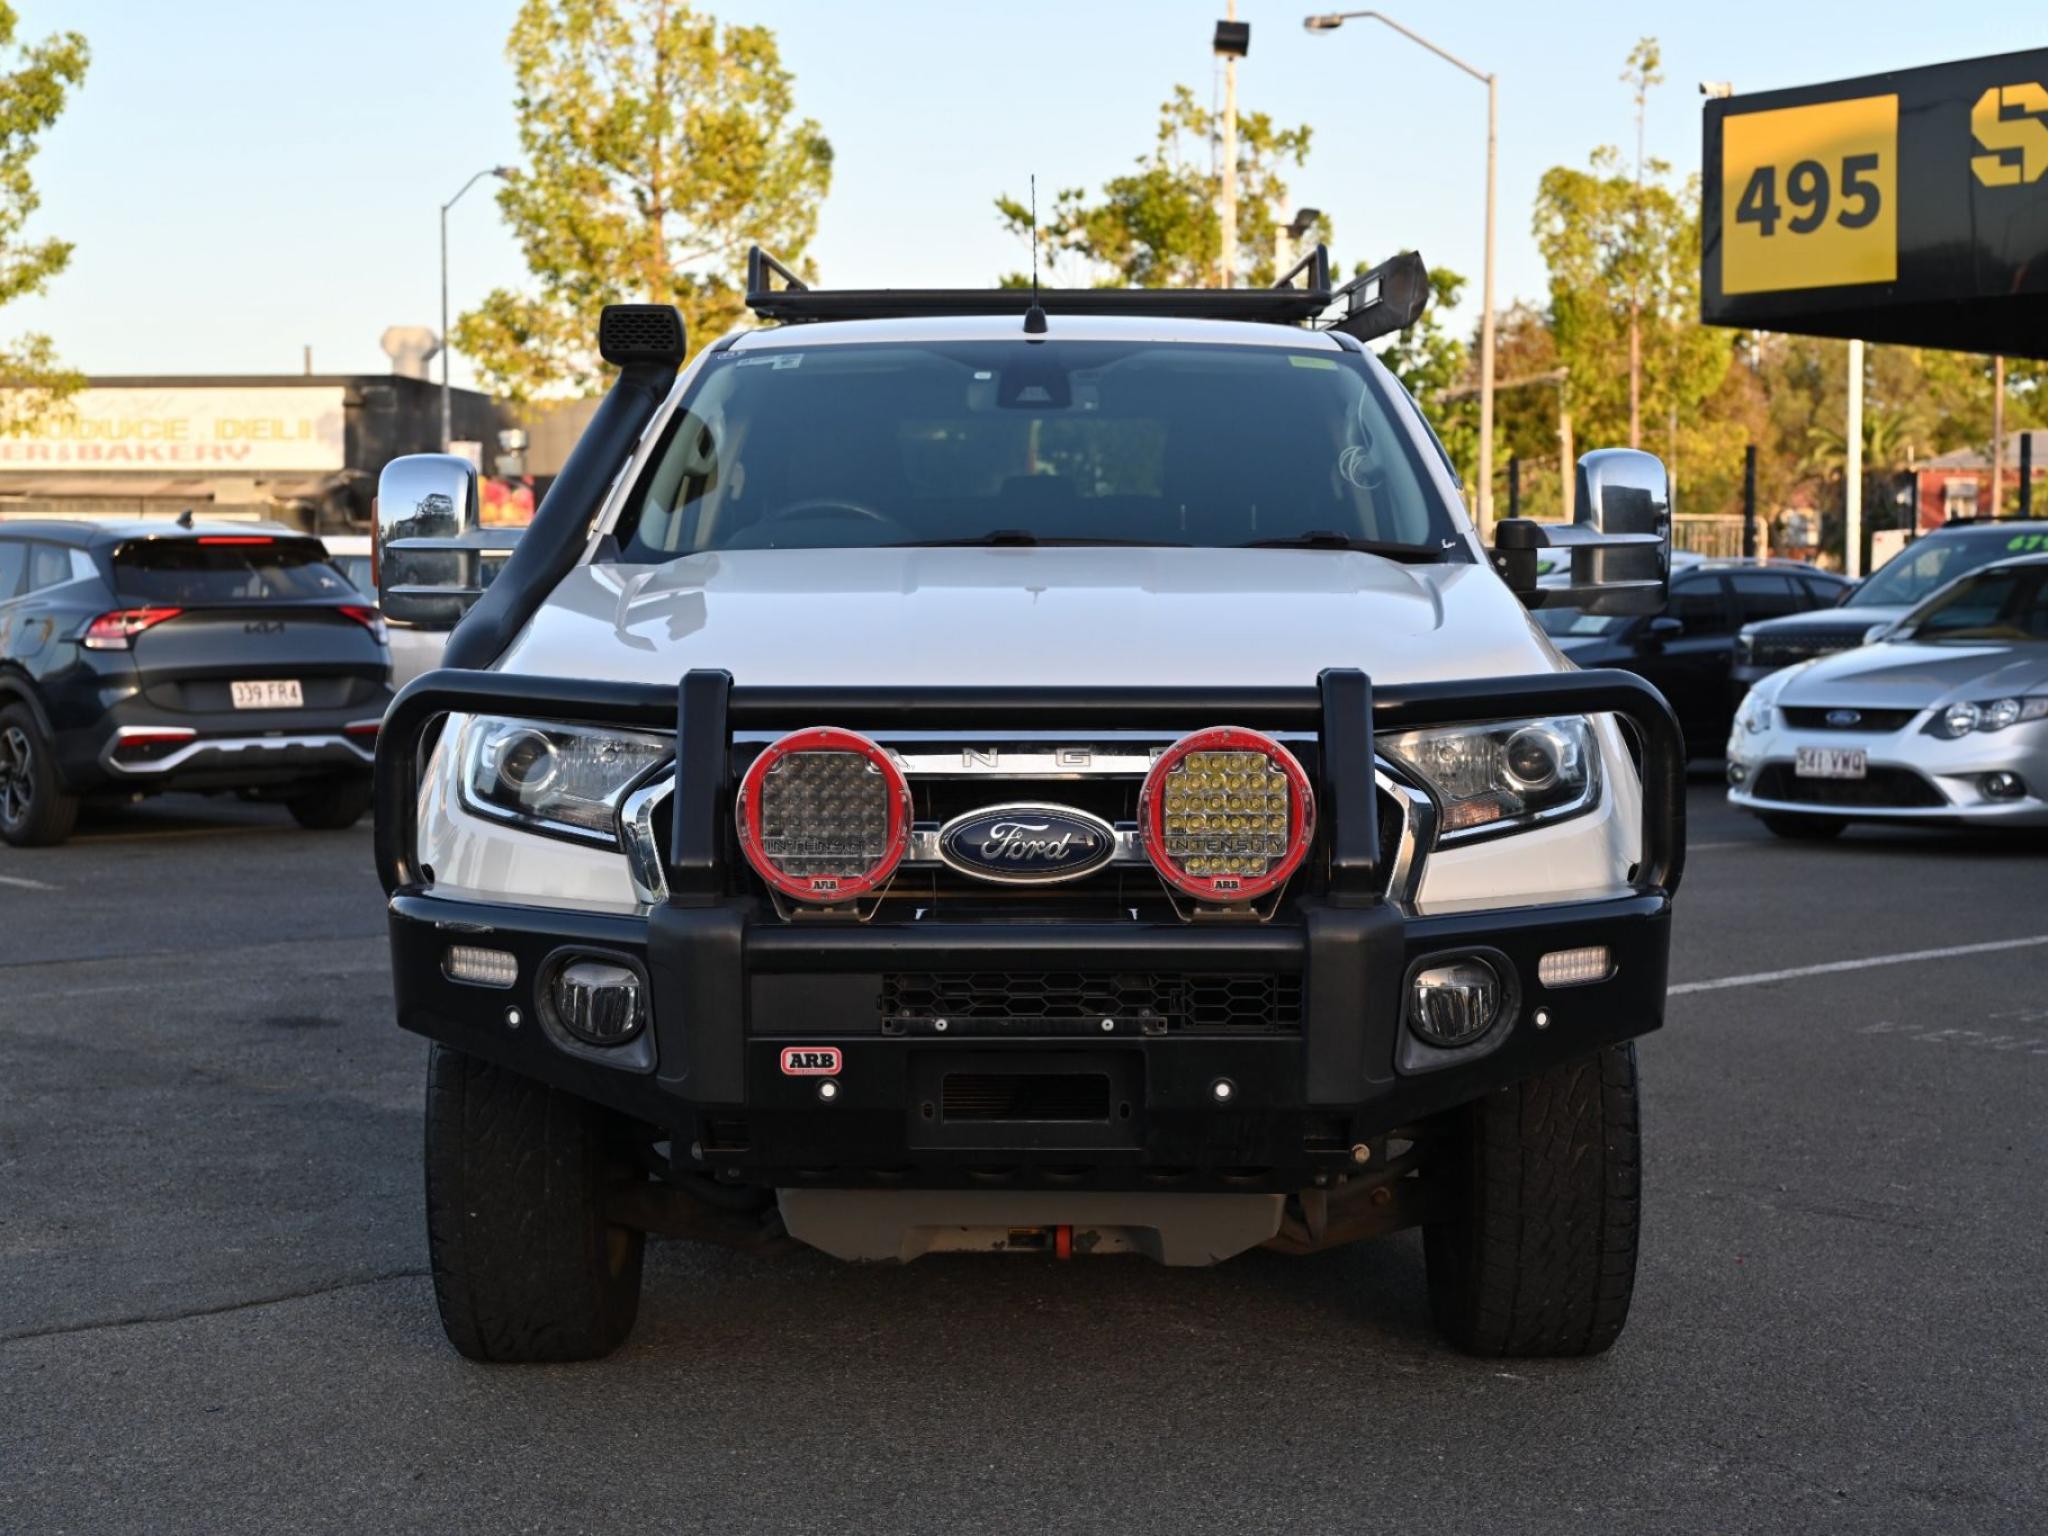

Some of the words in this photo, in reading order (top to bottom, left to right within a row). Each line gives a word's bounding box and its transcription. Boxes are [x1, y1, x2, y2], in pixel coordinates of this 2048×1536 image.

[1736, 153, 1881, 237] 495
[12, 418, 189, 440] ODUCE
[214, 418, 312, 440] DELI
[77, 445, 250, 462] BAKERY
[981, 822, 1072, 860] Ford
[1168, 839, 1283, 851] INTENSITY
[1214, 879, 1239, 889] ARB
[789, 1053, 835, 1069] ARB
